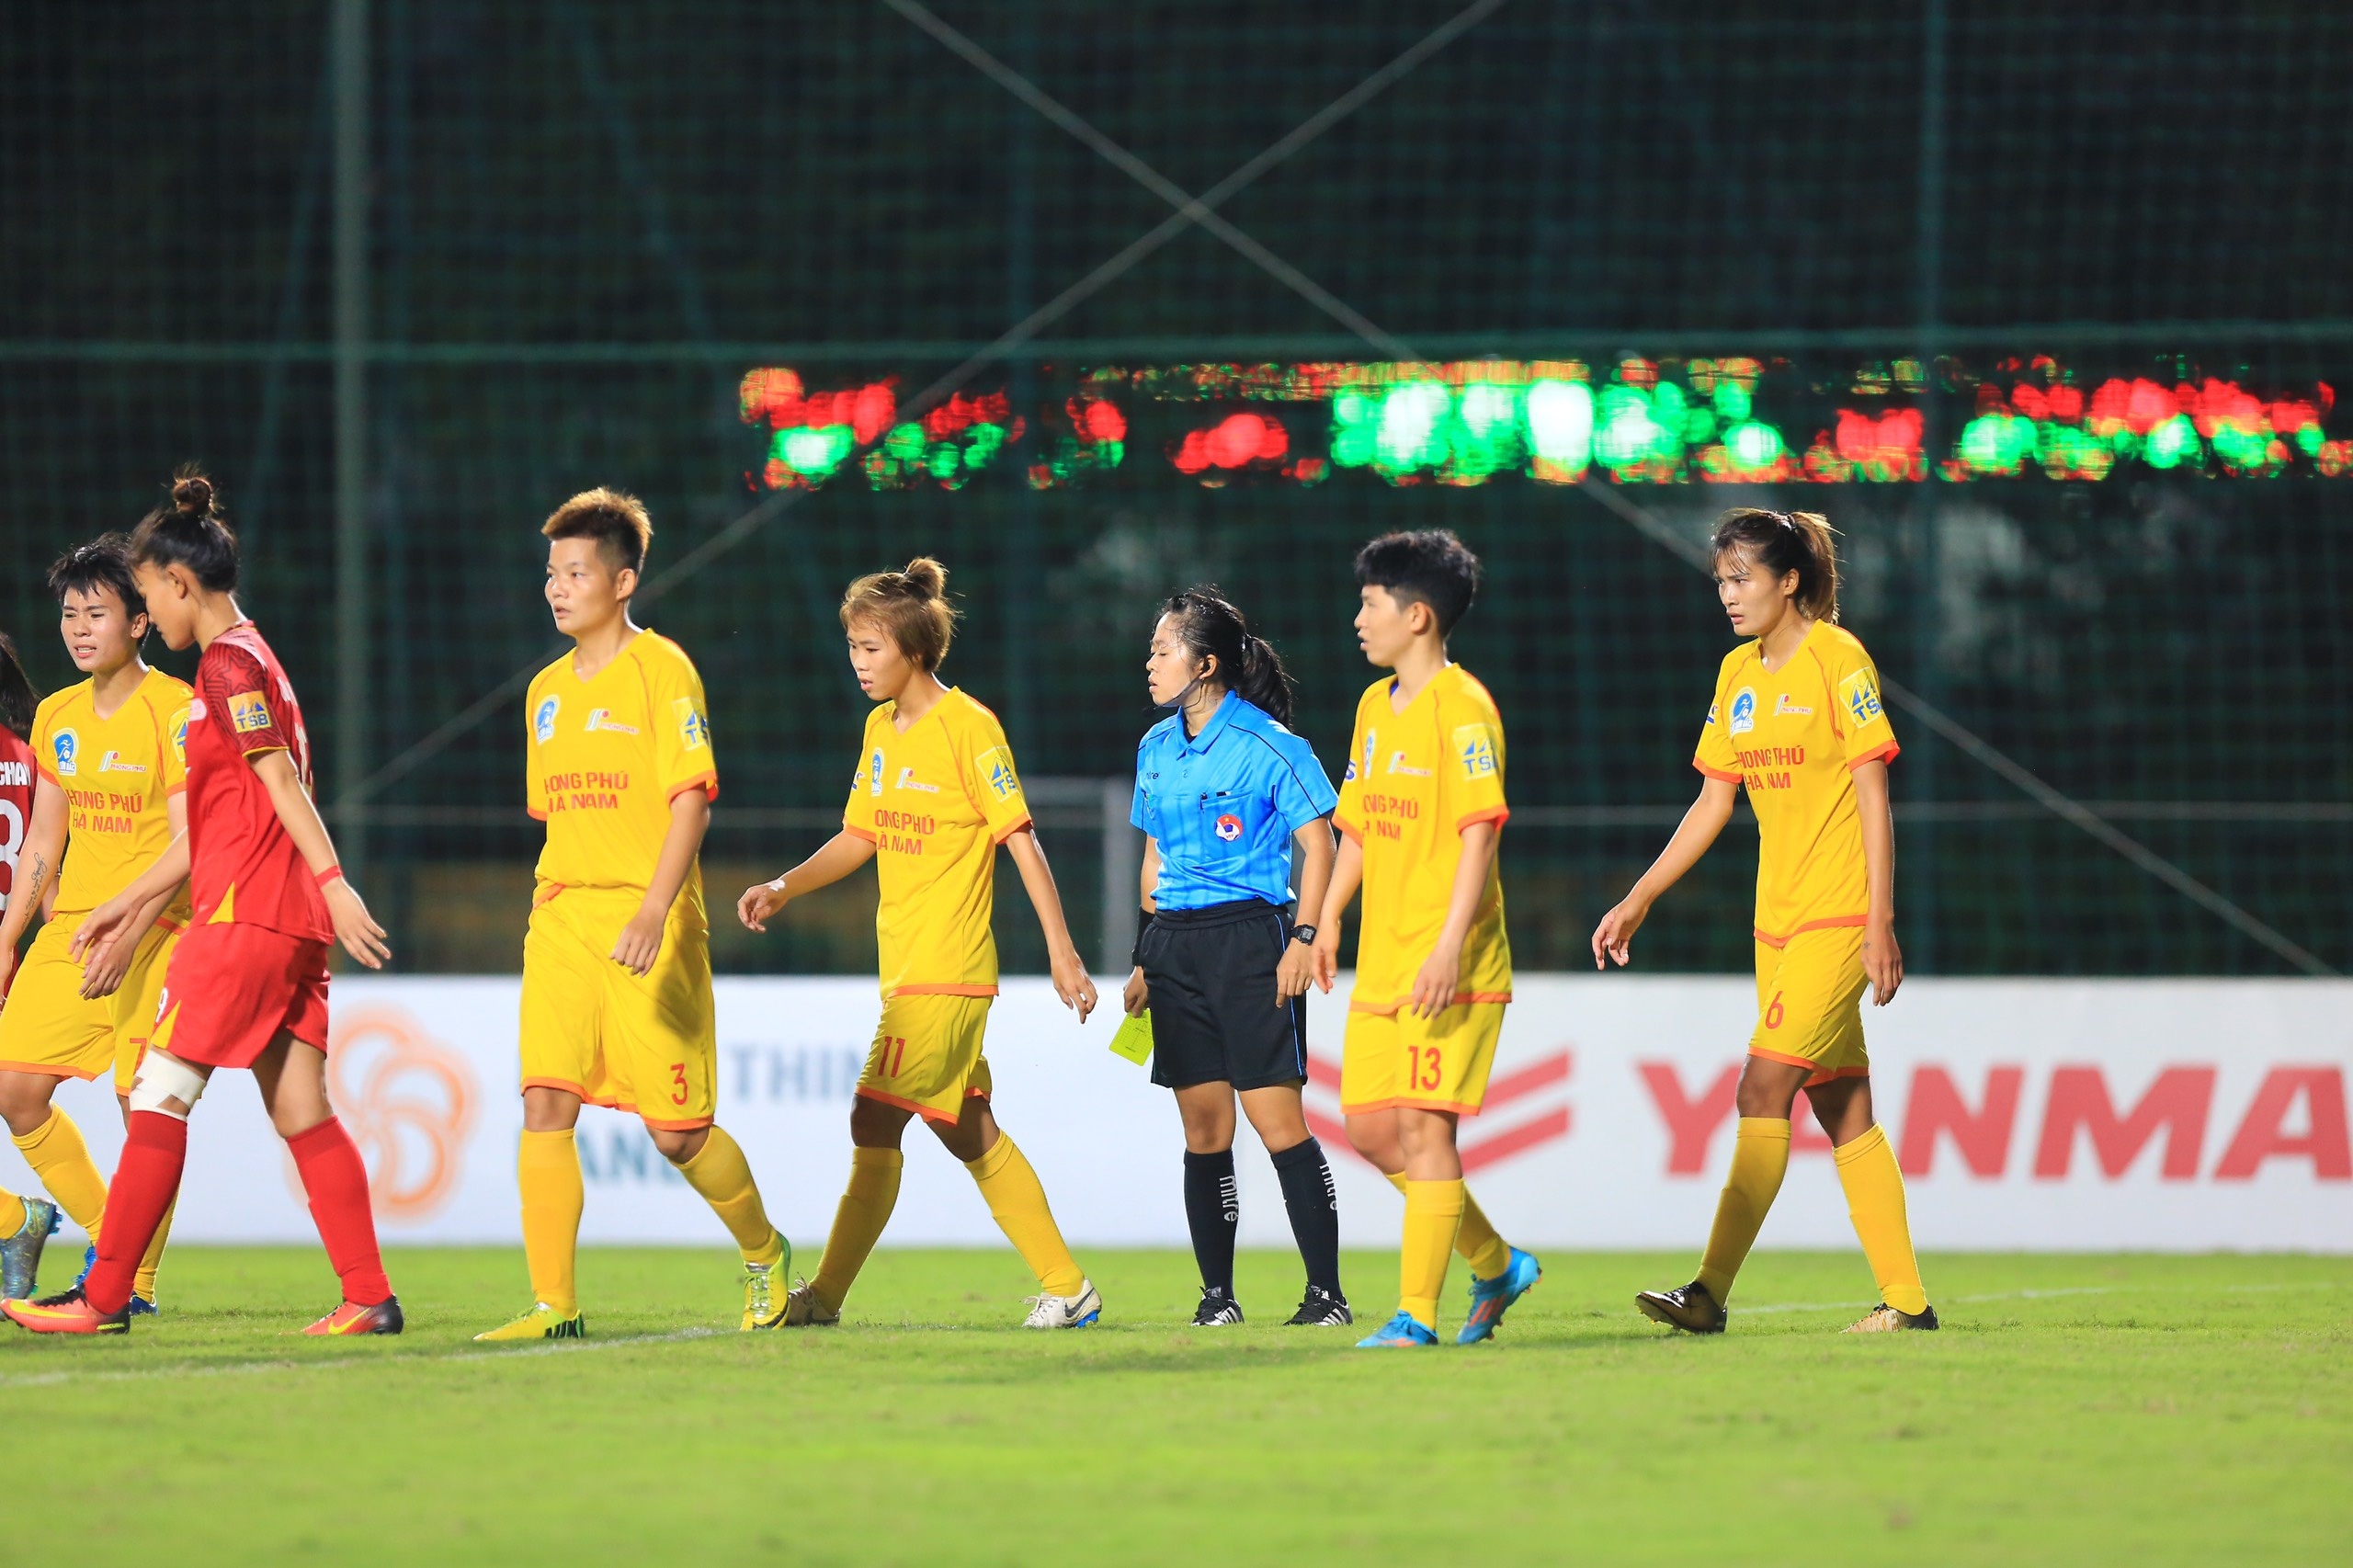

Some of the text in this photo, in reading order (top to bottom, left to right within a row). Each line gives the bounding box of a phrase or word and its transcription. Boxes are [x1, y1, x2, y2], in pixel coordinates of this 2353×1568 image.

[236, 713, 268, 730] TSB
[585, 770, 629, 790] PHÚ
[108, 793, 142, 812] PHÚ
[571, 793, 618, 809] NAM
[92, 815, 132, 834] NAM
[901, 814, 934, 835] PHÚ
[1765, 990, 1784, 1029] 6
[130, 1038, 147, 1076] 7
[878, 1036, 904, 1078] 11
[1408, 1045, 1441, 1091] 13
[670, 1062, 688, 1105] 3
[1220, 1176, 1239, 1222] mitre
